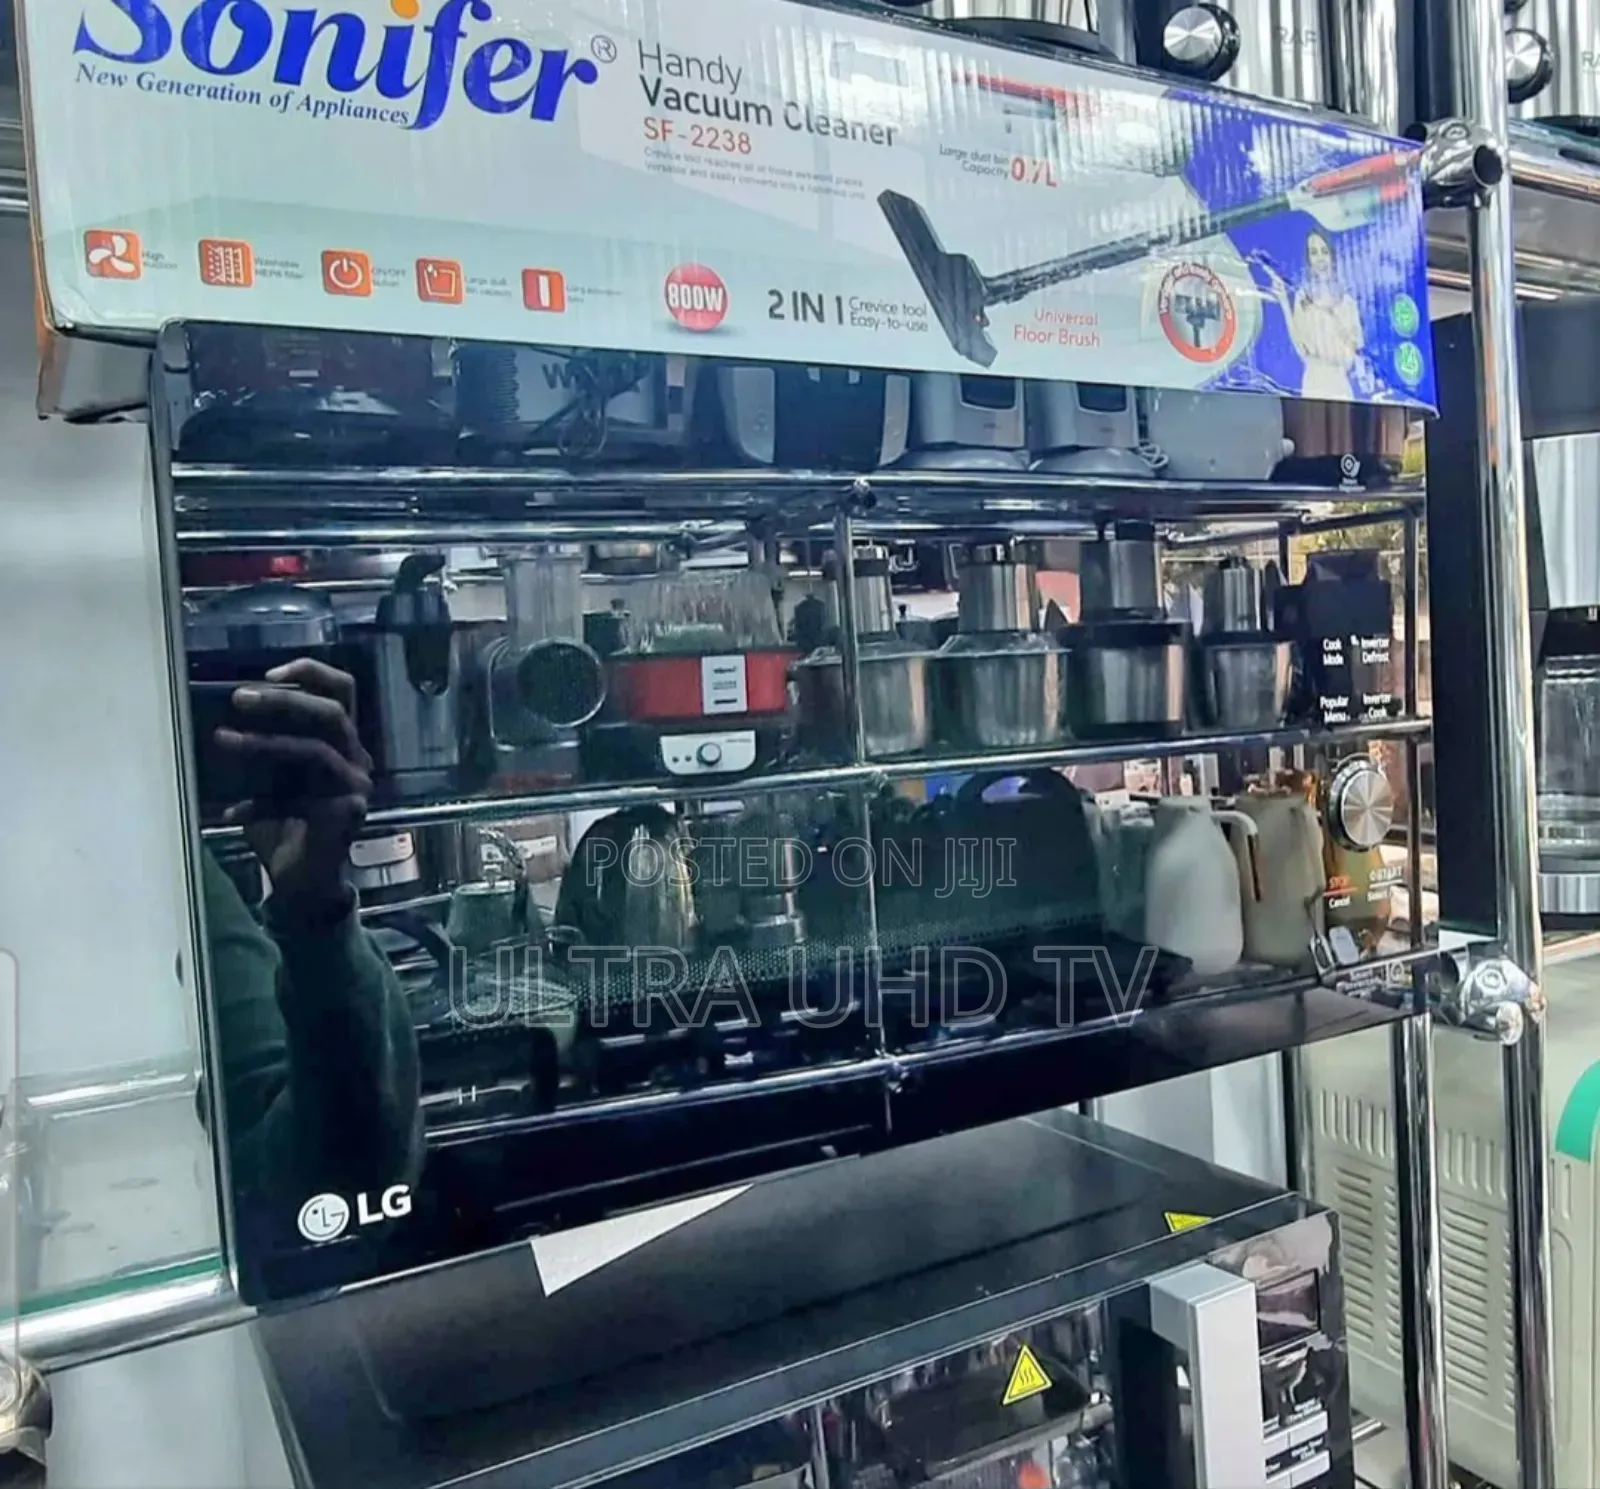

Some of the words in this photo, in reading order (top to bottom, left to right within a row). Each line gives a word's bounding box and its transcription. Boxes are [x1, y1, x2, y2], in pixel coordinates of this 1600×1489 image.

[638, 39, 742, 95] Handy
[75, 62, 129, 89] New
[136, 71, 262, 107] Generation
[269, 92, 294, 114] of
[296, 93, 409, 125] Appliances
[640, 74, 772, 127] Vacuum
[783, 101, 898, 147] Cleaner
[643, 116, 752, 154] SF-2238
[940, 144, 968, 161] Large
[970, 150, 991, 162] dust
[961, 160, 1009, 180] Capacity
[1011, 156, 1057, 187] 0.7L
[667, 283, 724, 313] 800W
[768, 289, 785, 321] 2
[792, 291, 825, 323] IN
[835, 296, 844, 325] 1
[849, 296, 898, 315] Crevice
[902, 300, 927, 316] tool
[850, 313, 928, 332] Easy-to-use
[1034, 307, 1099, 326] Universal
[1014, 324, 1052, 343] Floor
[1058, 330, 1100, 347] Brush
[1322, 638, 1342, 651] Cook
[1323, 653, 1344, 665] Mode
[1320, 695, 1349, 709] Popular
[1368, 706, 1387, 719] Cook
[357, 1184, 412, 1225] LG
